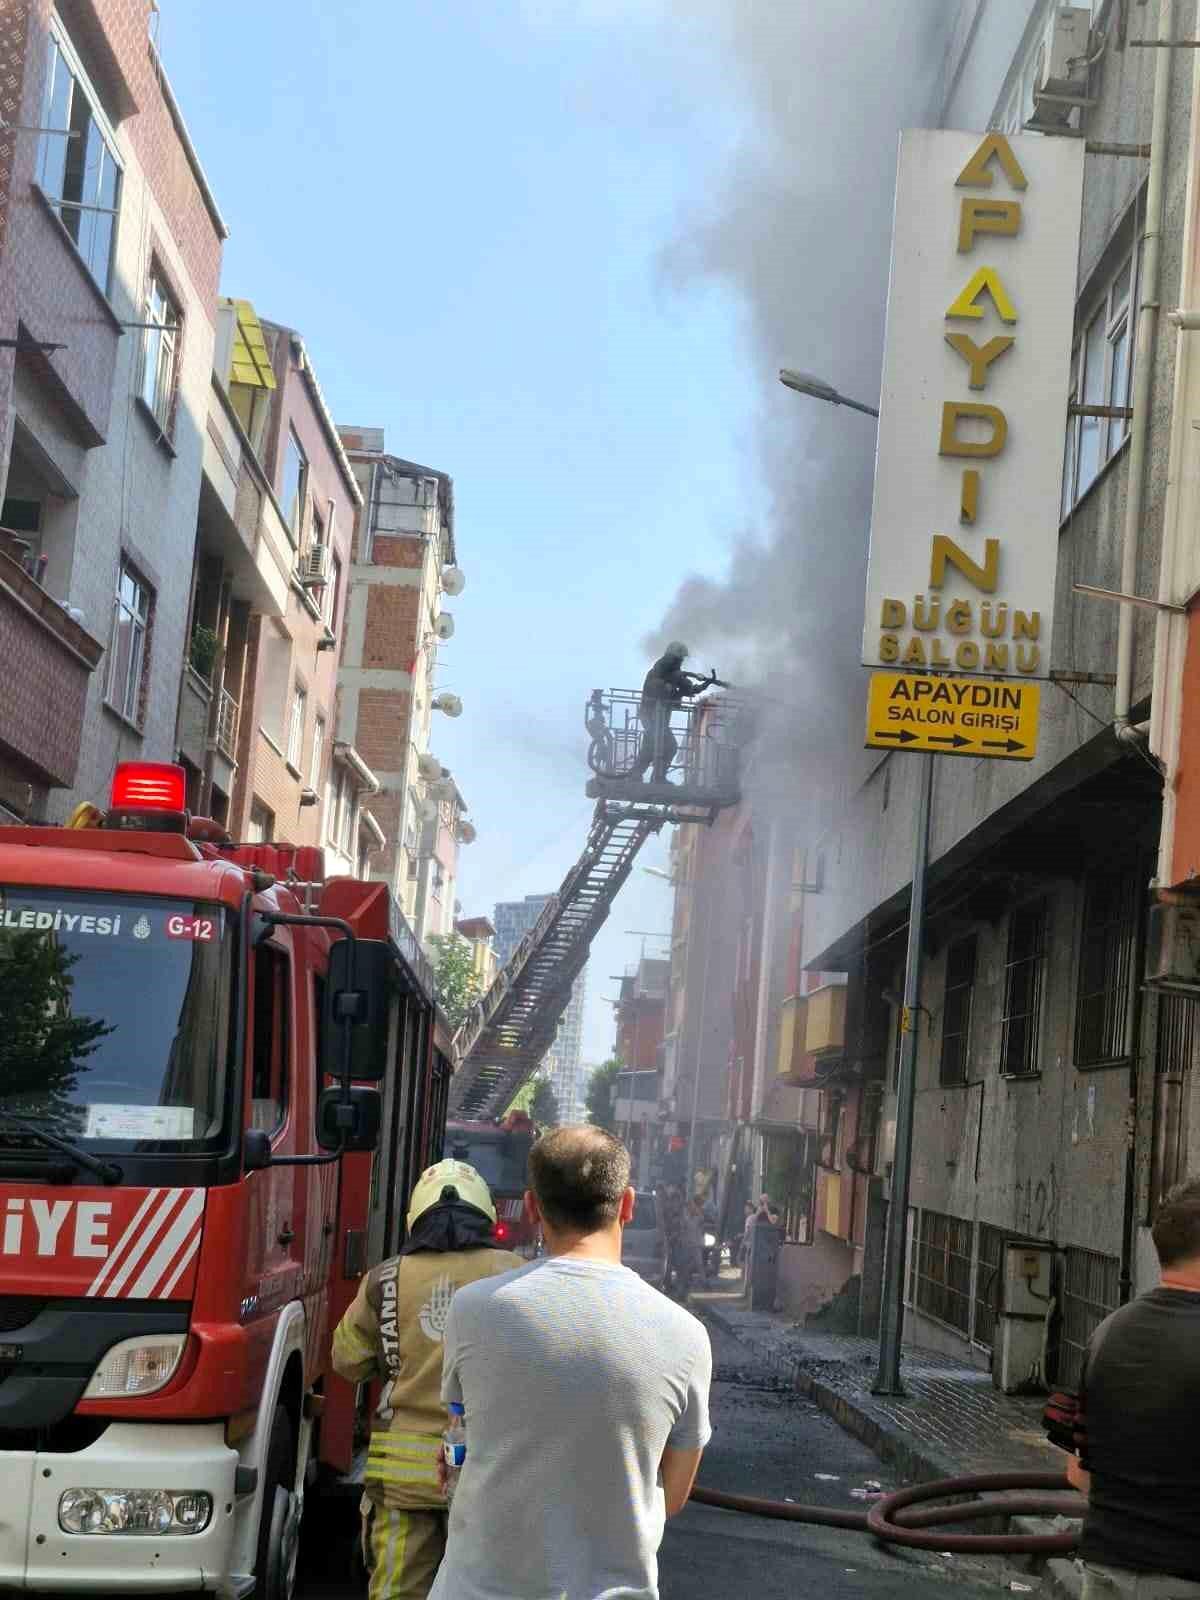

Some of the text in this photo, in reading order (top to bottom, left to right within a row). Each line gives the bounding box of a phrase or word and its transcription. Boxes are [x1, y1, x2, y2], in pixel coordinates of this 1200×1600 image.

[931, 129, 1028, 593] APAYDIN
[880, 592, 1041, 641] DÜĞÜN
[879, 633, 1041, 673] SALONU
[890, 679, 1022, 710] APAYDIN
[888, 705, 955, 725] SALON
[168, 915, 212, 939] G-12
